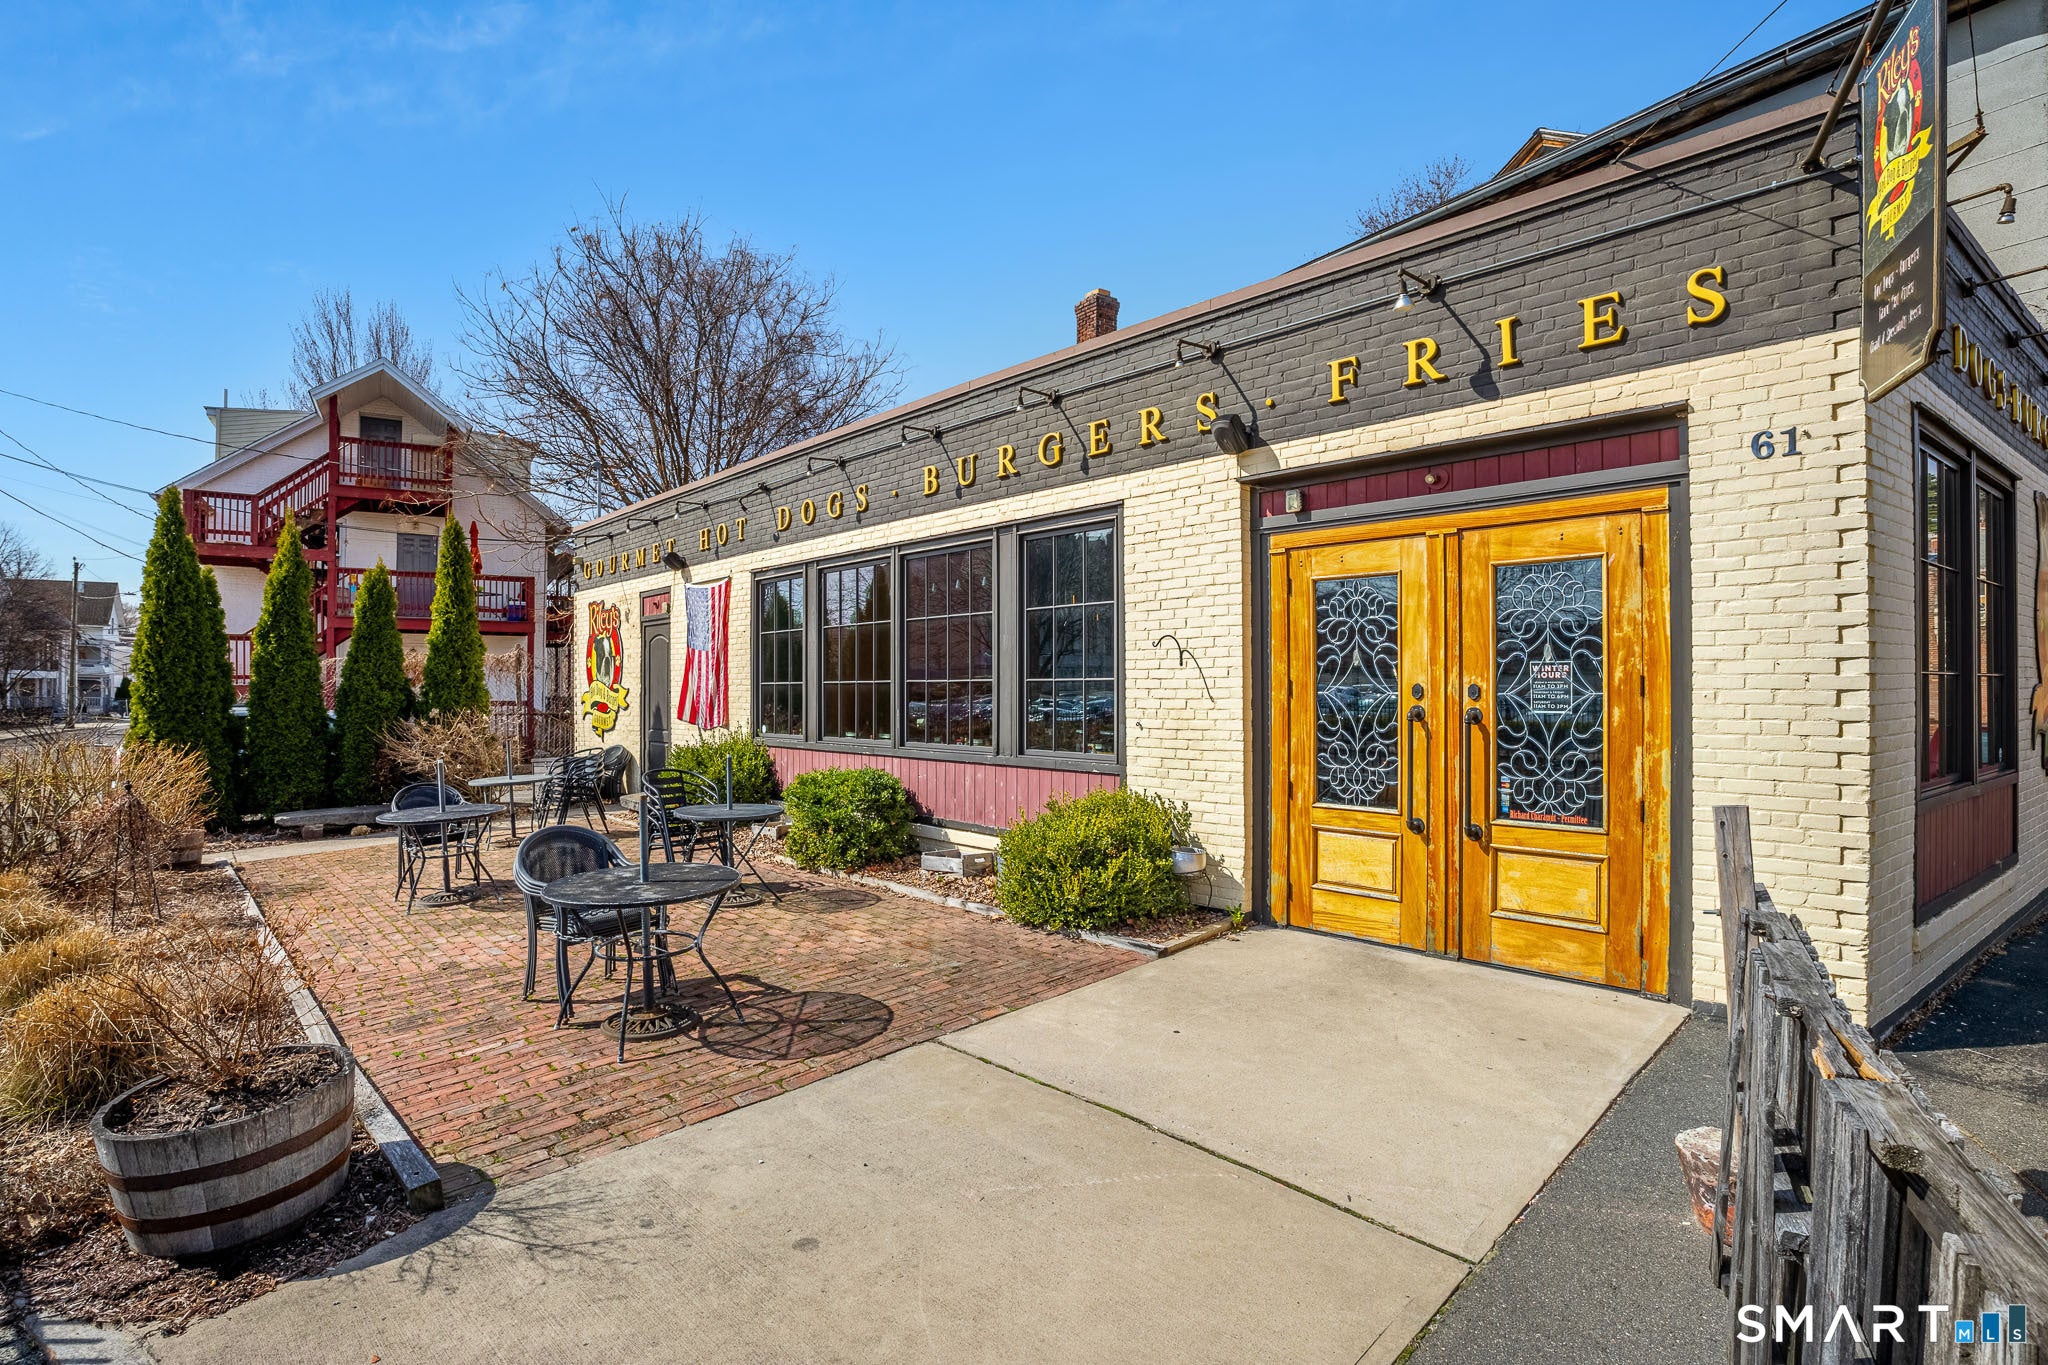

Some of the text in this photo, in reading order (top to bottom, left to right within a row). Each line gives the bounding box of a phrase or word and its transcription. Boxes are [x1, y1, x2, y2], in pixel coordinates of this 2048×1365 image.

[1876, 26, 1920, 104] Riley's
[1953, 323, 2007, 410] DOGS
[582, 265, 1729, 580] GOURMET HOT DOGS BURGERS FRIES
[1751, 426, 1802, 460] 61
[588, 602, 620, 637] Riley's
[1532, 664, 1569, 672] WINTER
[1509, 809, 1531, 820] Richard
[1561, 815, 1588, 825] Permittee
